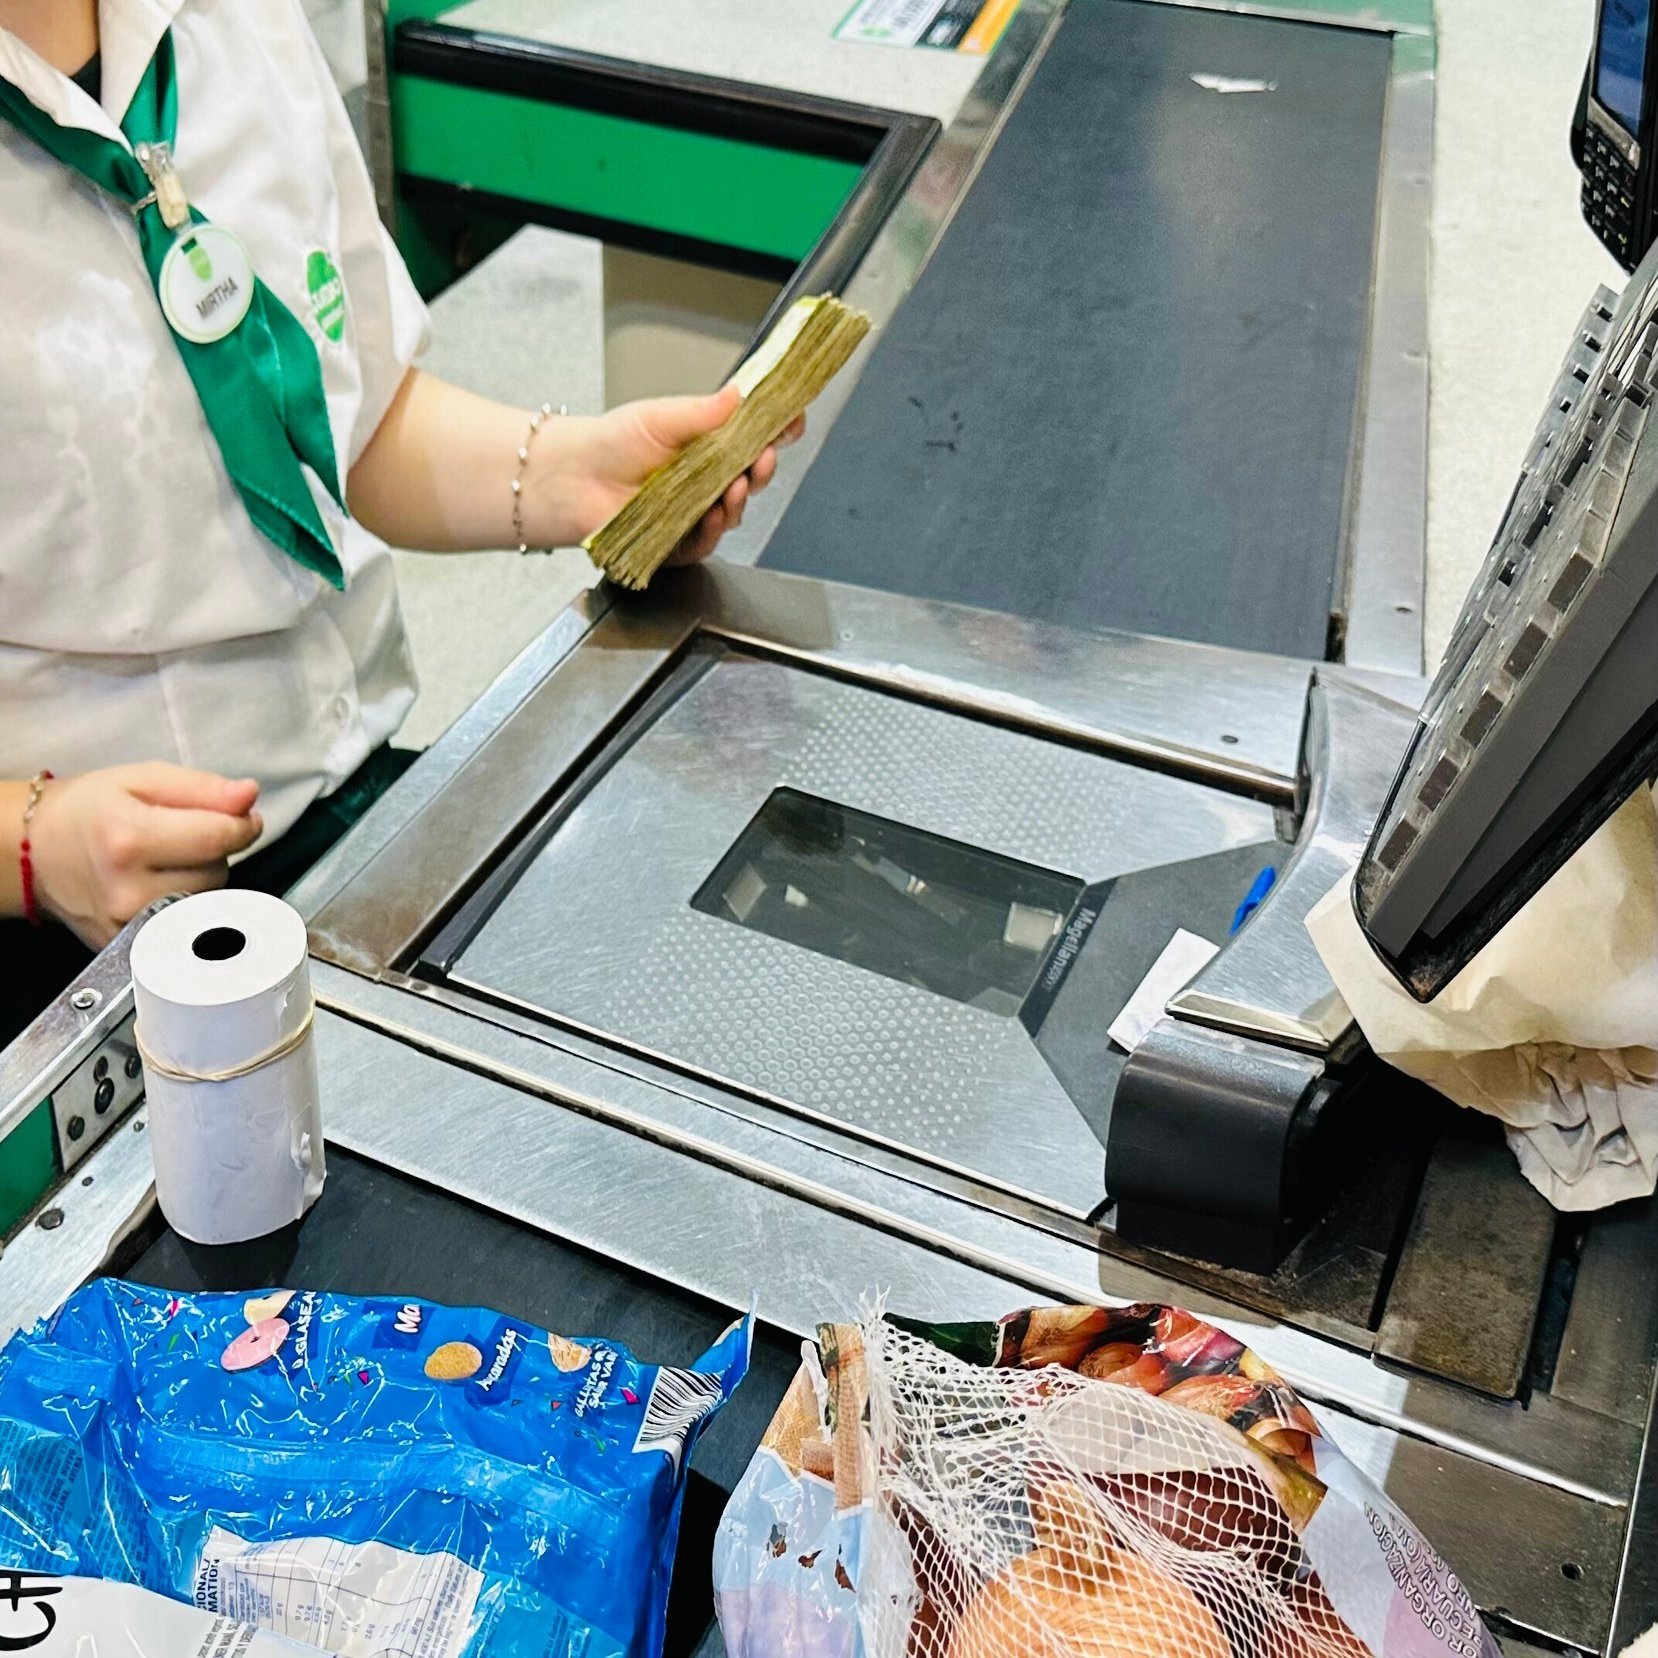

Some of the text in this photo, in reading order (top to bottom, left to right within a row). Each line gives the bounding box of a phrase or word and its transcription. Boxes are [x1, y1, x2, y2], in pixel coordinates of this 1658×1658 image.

[196, 277, 238, 319] MIRTHA
[1054, 908, 1097, 967] Magellan
[1364, 1501, 1445, 1640] ORGANIZACION
